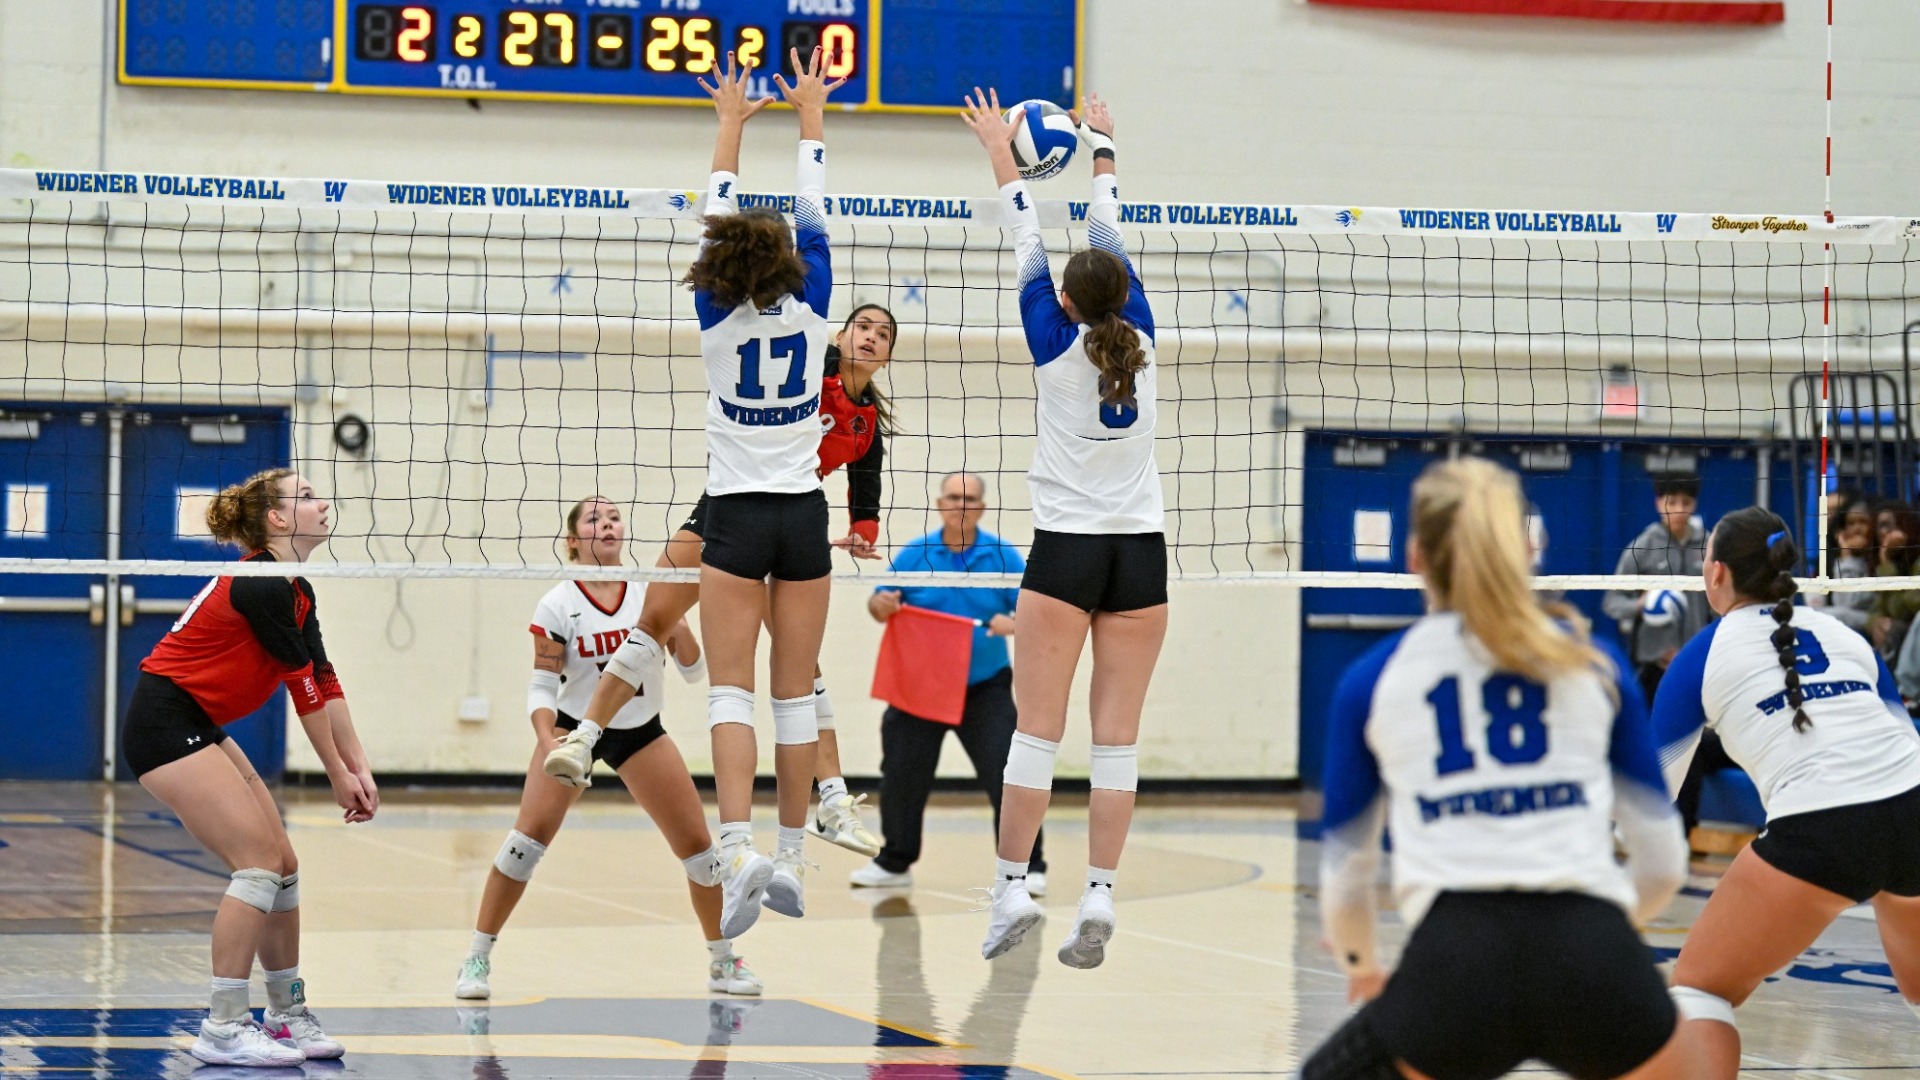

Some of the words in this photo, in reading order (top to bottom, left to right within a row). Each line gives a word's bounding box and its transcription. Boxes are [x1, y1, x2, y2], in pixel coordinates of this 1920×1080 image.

[398, 8, 431, 61] 2
[455, 16, 480, 57] 2
[504, 12, 573, 66] 27
[647, 17, 715, 73] 25
[738, 27, 764, 68] 2
[822, 24, 854, 78] 0
[36, 172, 138, 194] WIDENER
[144, 175, 285, 200] VOLLEYBALL
[324, 181, 348, 203] W
[387, 183, 487, 207] WIDENER
[492, 187, 629, 209] VOLLEYBALL
[838, 198, 972, 219] VOLLEYBALL
[1068, 202, 1161, 223] WNER
[1167, 206, 1297, 226] VOLLEYBALL
[1399, 209, 1490, 230] WIDENER
[1496, 212, 1621, 233] VOLLEYBALL
[1657, 214, 1677, 232] W
[1711, 215, 1759, 233] Stronger
[1762, 216, 1808, 234] Together
[735, 330, 808, 399] 17
[1425, 671, 1549, 779] 18
